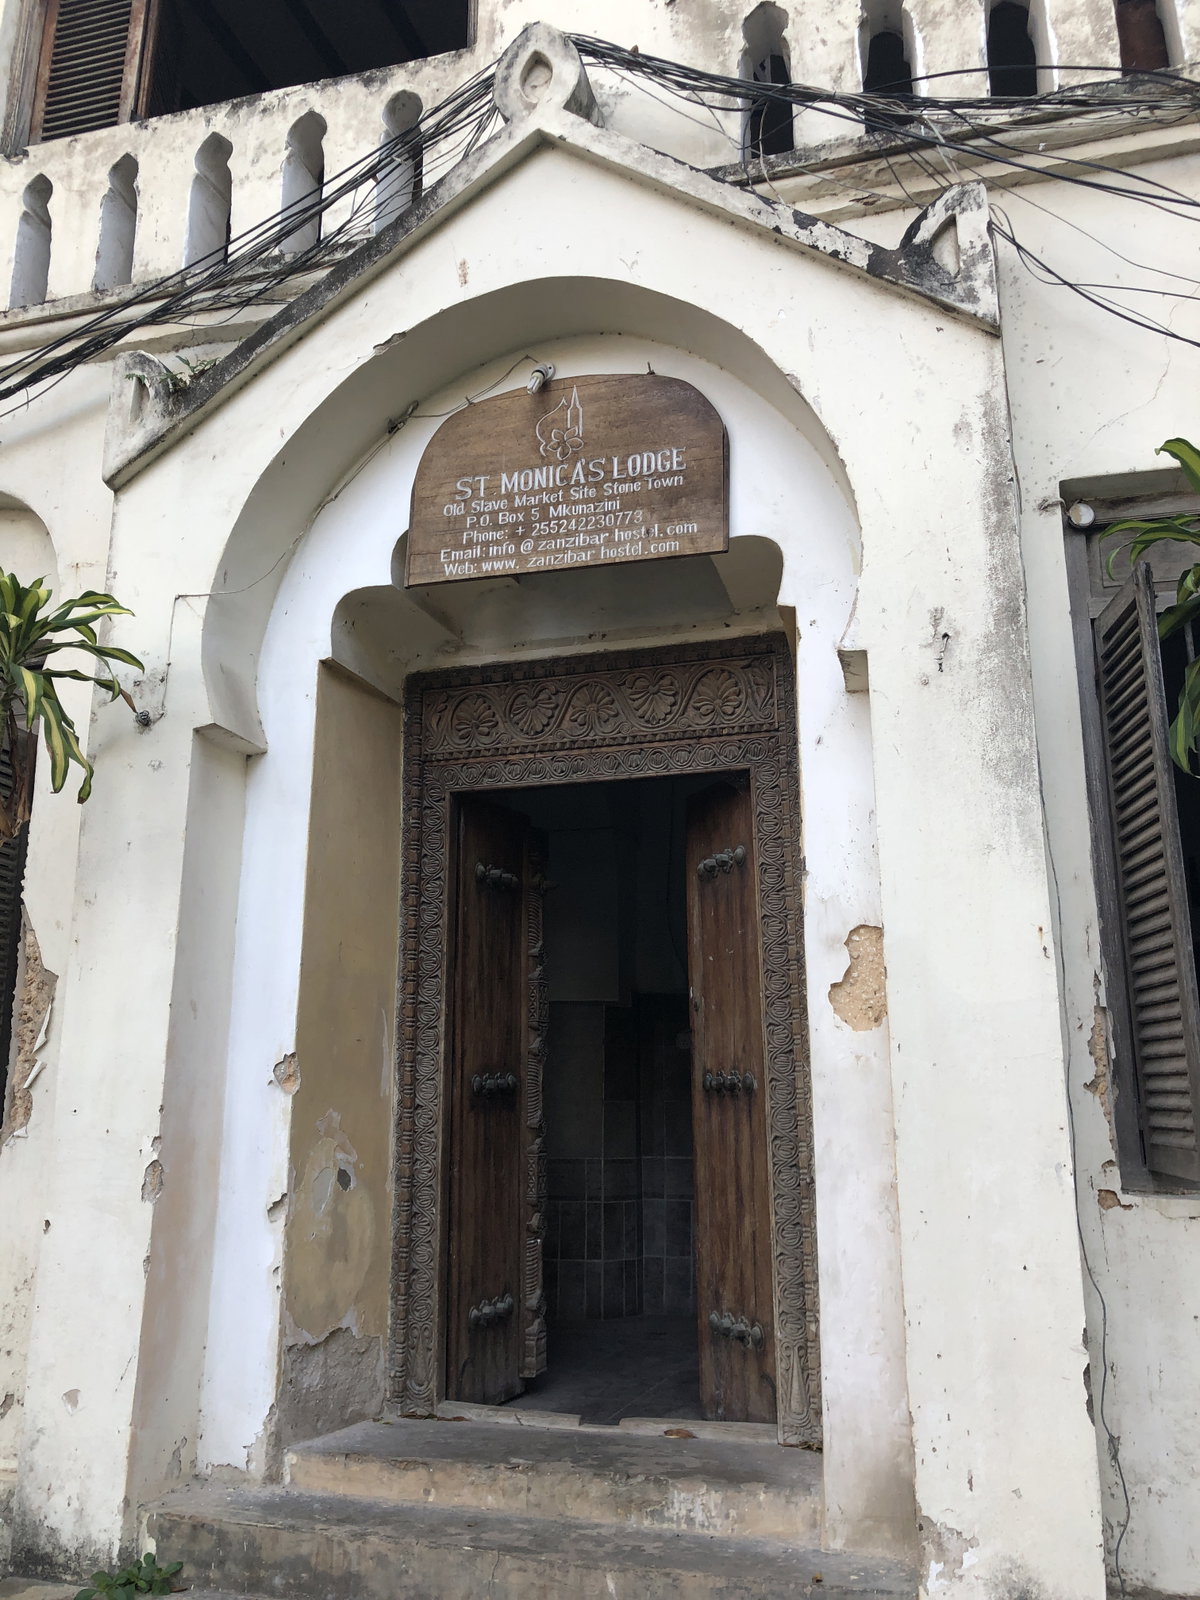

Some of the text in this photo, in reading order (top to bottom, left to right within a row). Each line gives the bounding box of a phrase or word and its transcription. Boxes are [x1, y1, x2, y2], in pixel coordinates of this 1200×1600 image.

[501, 457, 606, 495] MONICA'S
[611, 446, 687, 480] LODGE
[443, 475, 684, 517] Old Slave Market Site Stone Town
[466, 497, 620, 529] P.O. Box 5 Mkunazini
[463, 529, 508, 545] Phone:
[531, 509, 644, 537] 255242230773
[440, 547, 486, 562] Email:
[489, 541, 515, 557] info
[537, 531, 609, 551] zanzibar
[444, 560, 478, 577] Web:
[482, 559, 520, 573] www.
[527, 549, 596, 568] zanzibar
